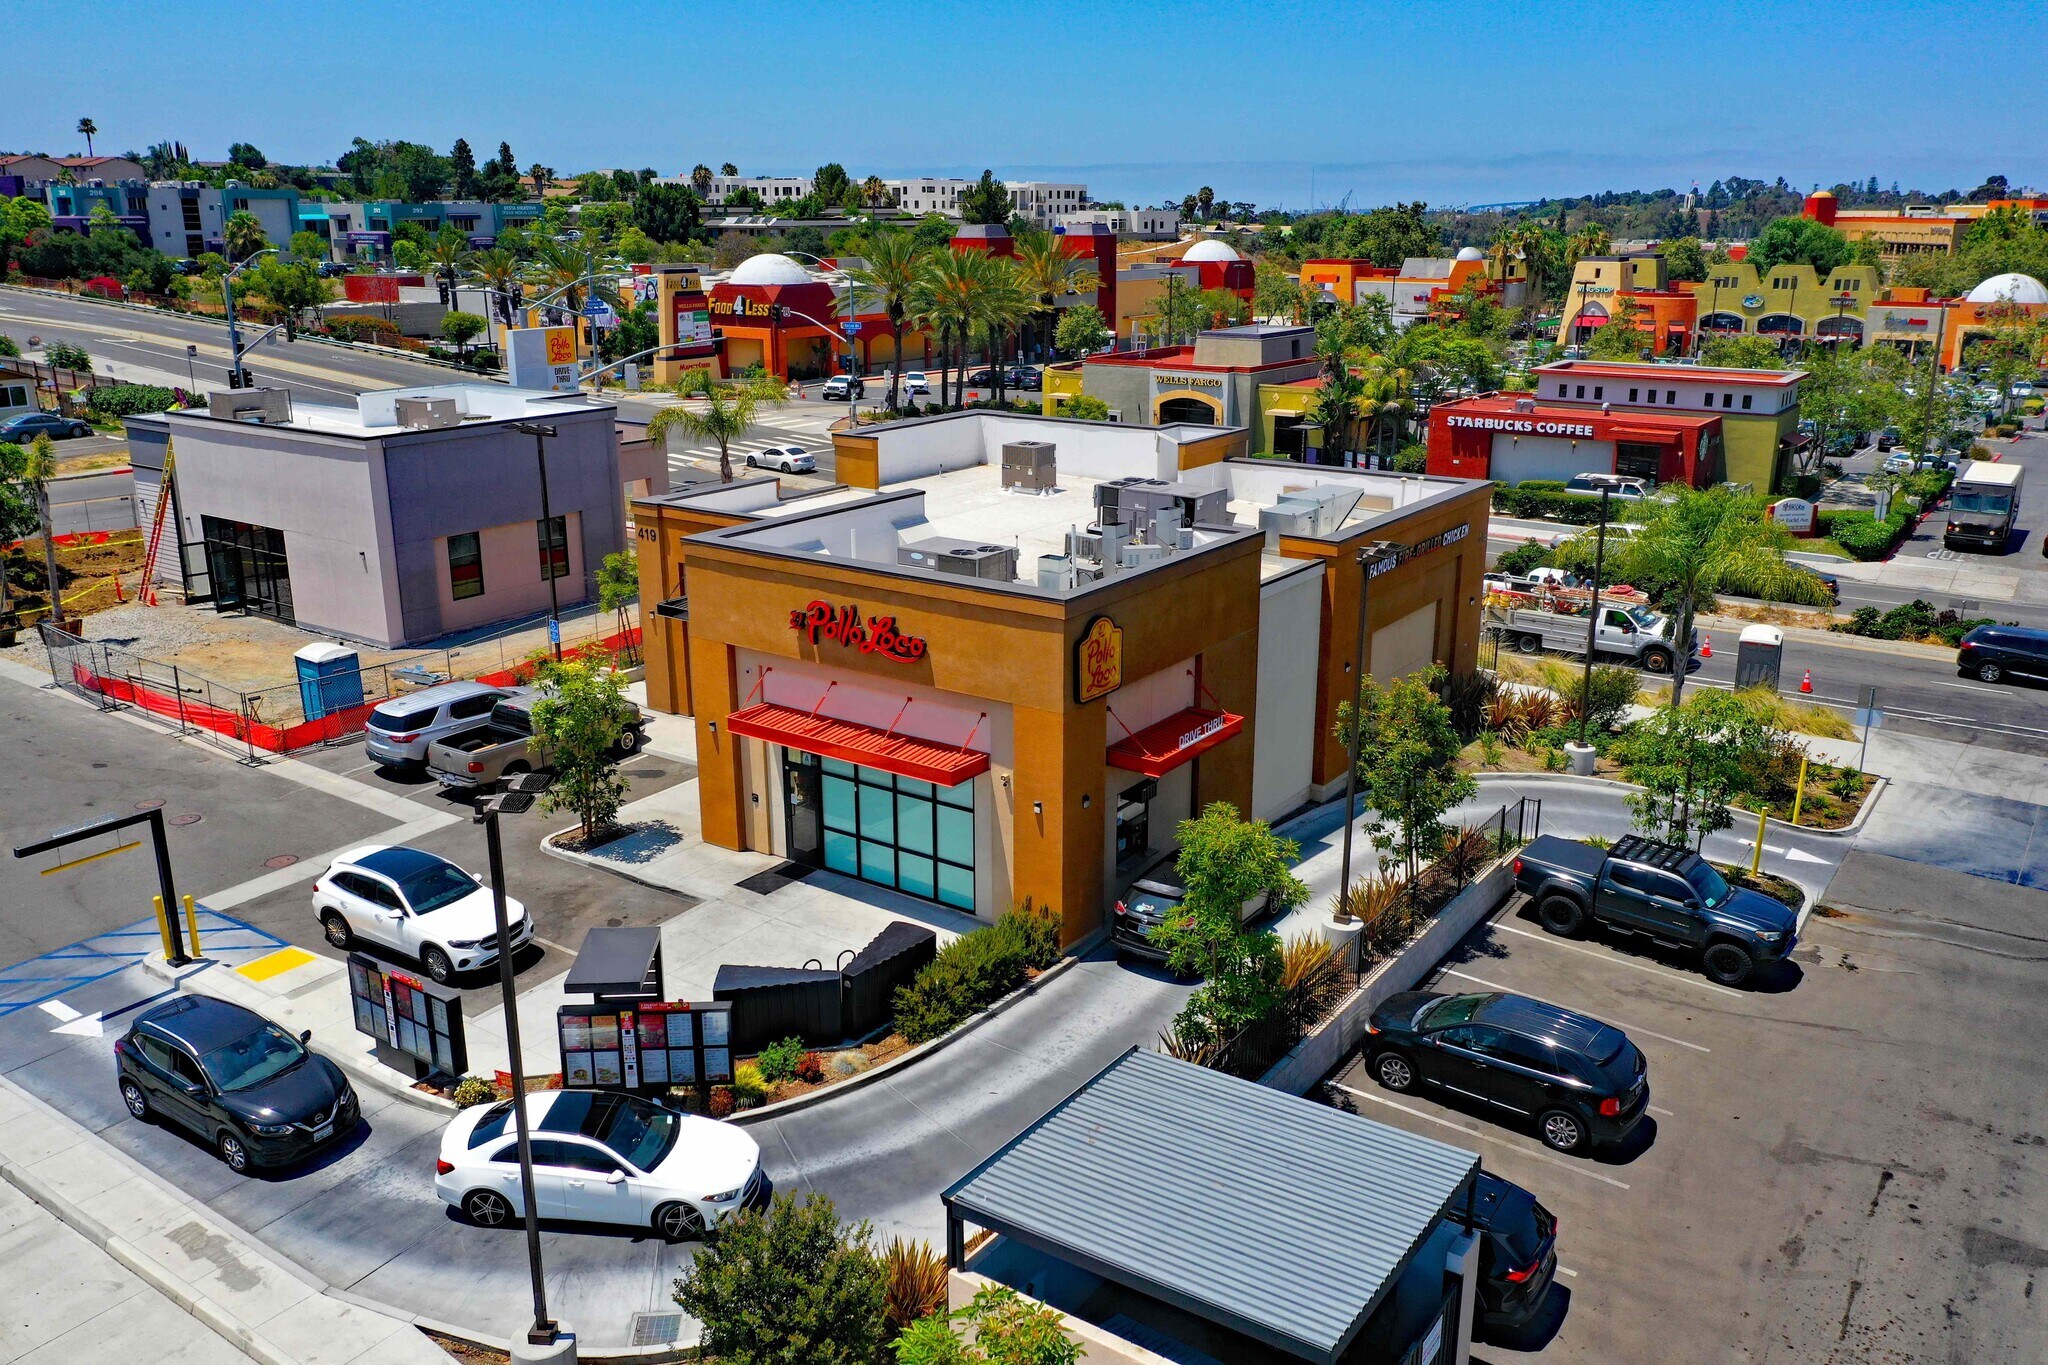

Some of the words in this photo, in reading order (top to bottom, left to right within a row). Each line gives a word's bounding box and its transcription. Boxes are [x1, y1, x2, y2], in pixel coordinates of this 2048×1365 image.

[733, 295, 744, 316] 4
[551, 336, 570, 353] Pollo
[552, 350, 571, 362] Loco
[556, 375, 571, 383] THRU
[1155, 375, 1189, 386] WELLS
[1189, 376, 1223, 387] FARGO
[1446, 415, 1533, 432] STARBUCKS
[1536, 422, 1593, 437] COFFEE
[638, 527, 656, 542] 419
[1369, 555, 1397, 580] FAMOUS
[1442, 523, 1470, 546] CHICKEN
[806, 599, 866, 648] Pollo
[858, 615, 927, 664] Loco
[1087, 633, 1115, 674] Pollo
[1086, 663, 1117, 693] Loco
[1178, 726, 1202, 750] DRIVE
[1203, 714, 1225, 737] THRU
